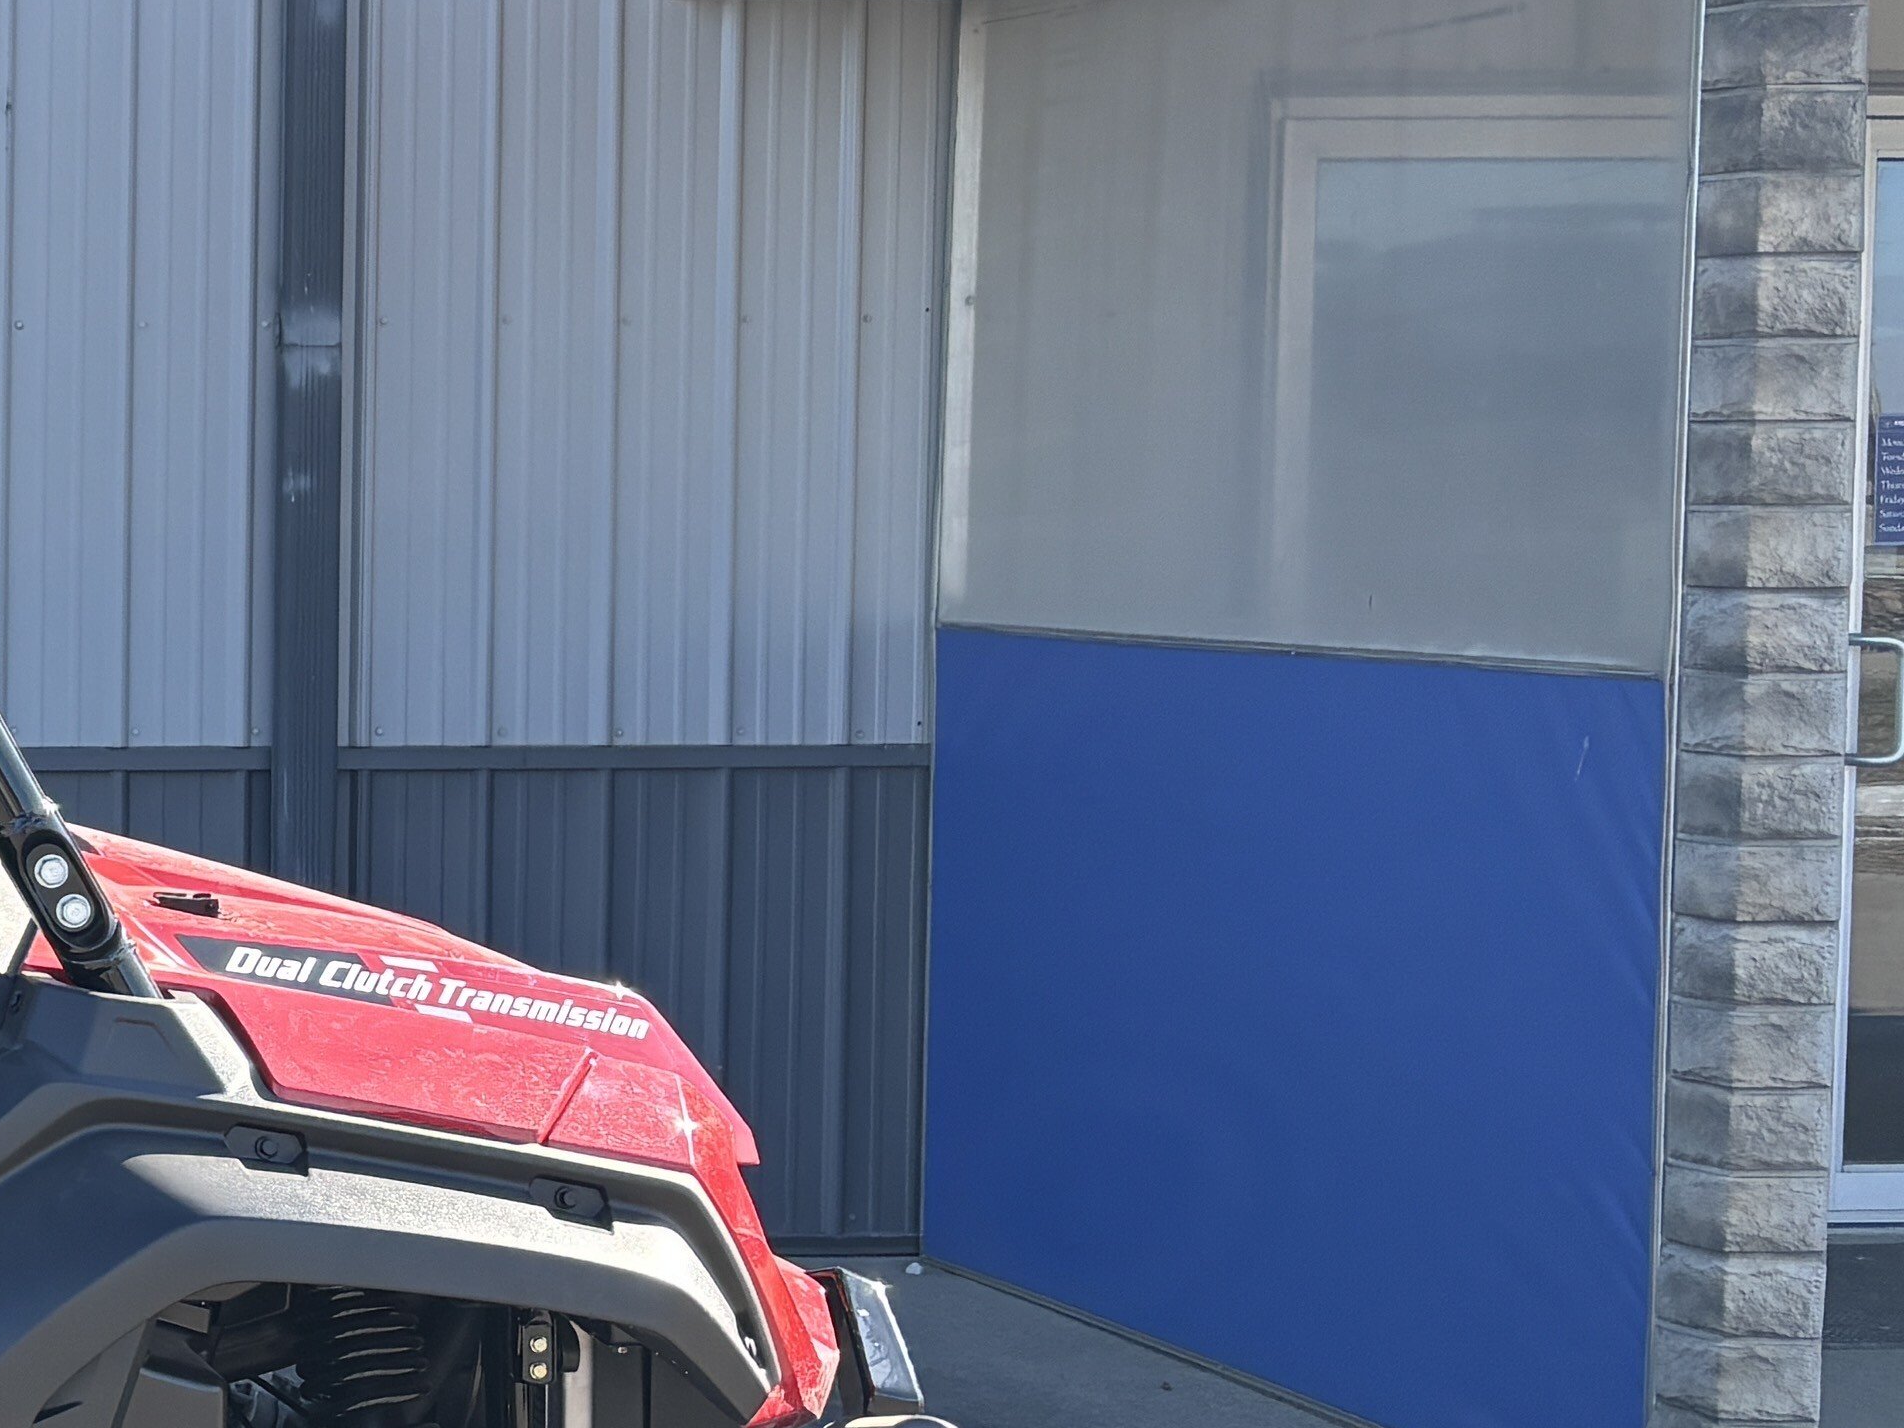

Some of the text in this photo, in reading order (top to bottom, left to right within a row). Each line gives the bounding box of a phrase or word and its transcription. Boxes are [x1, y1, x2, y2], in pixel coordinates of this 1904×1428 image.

[225, 946, 650, 1040] Dual Clutch Transmission
